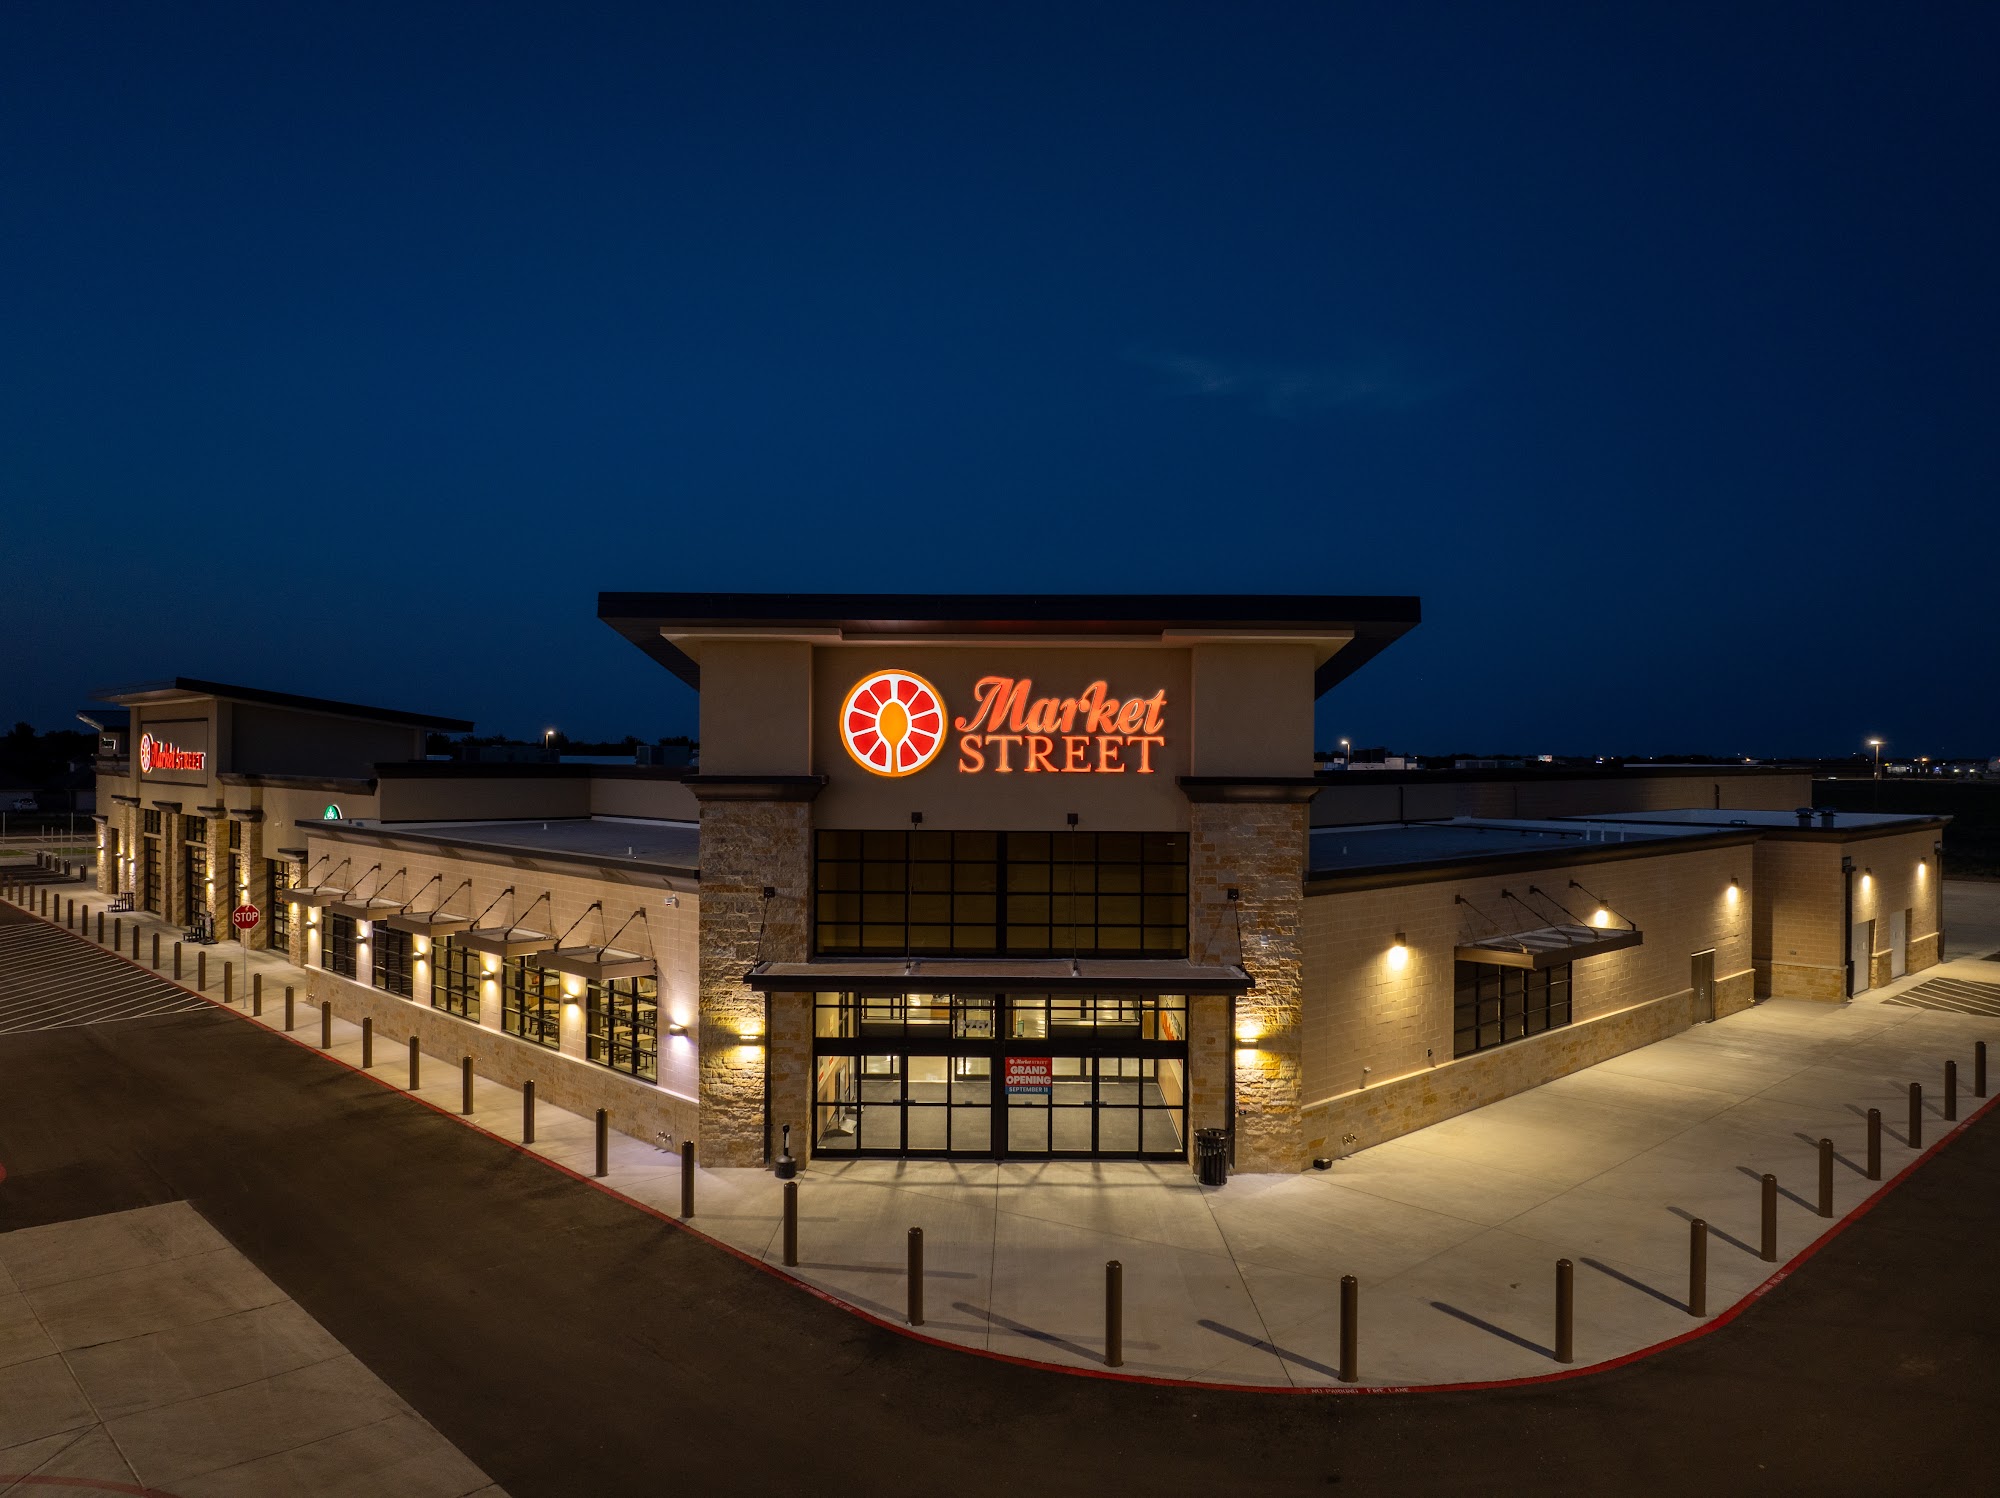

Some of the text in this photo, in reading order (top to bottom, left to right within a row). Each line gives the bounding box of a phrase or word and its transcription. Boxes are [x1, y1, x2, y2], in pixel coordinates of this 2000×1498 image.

[954, 675, 1168, 734] Market
[176, 752, 206, 770] STREET
[958, 734, 1166, 774] STREET
[234, 911, 258, 922] STOP
[1010, 1065, 1047, 1075] GRAND
[1005, 1075, 1052, 1085] OPENING
